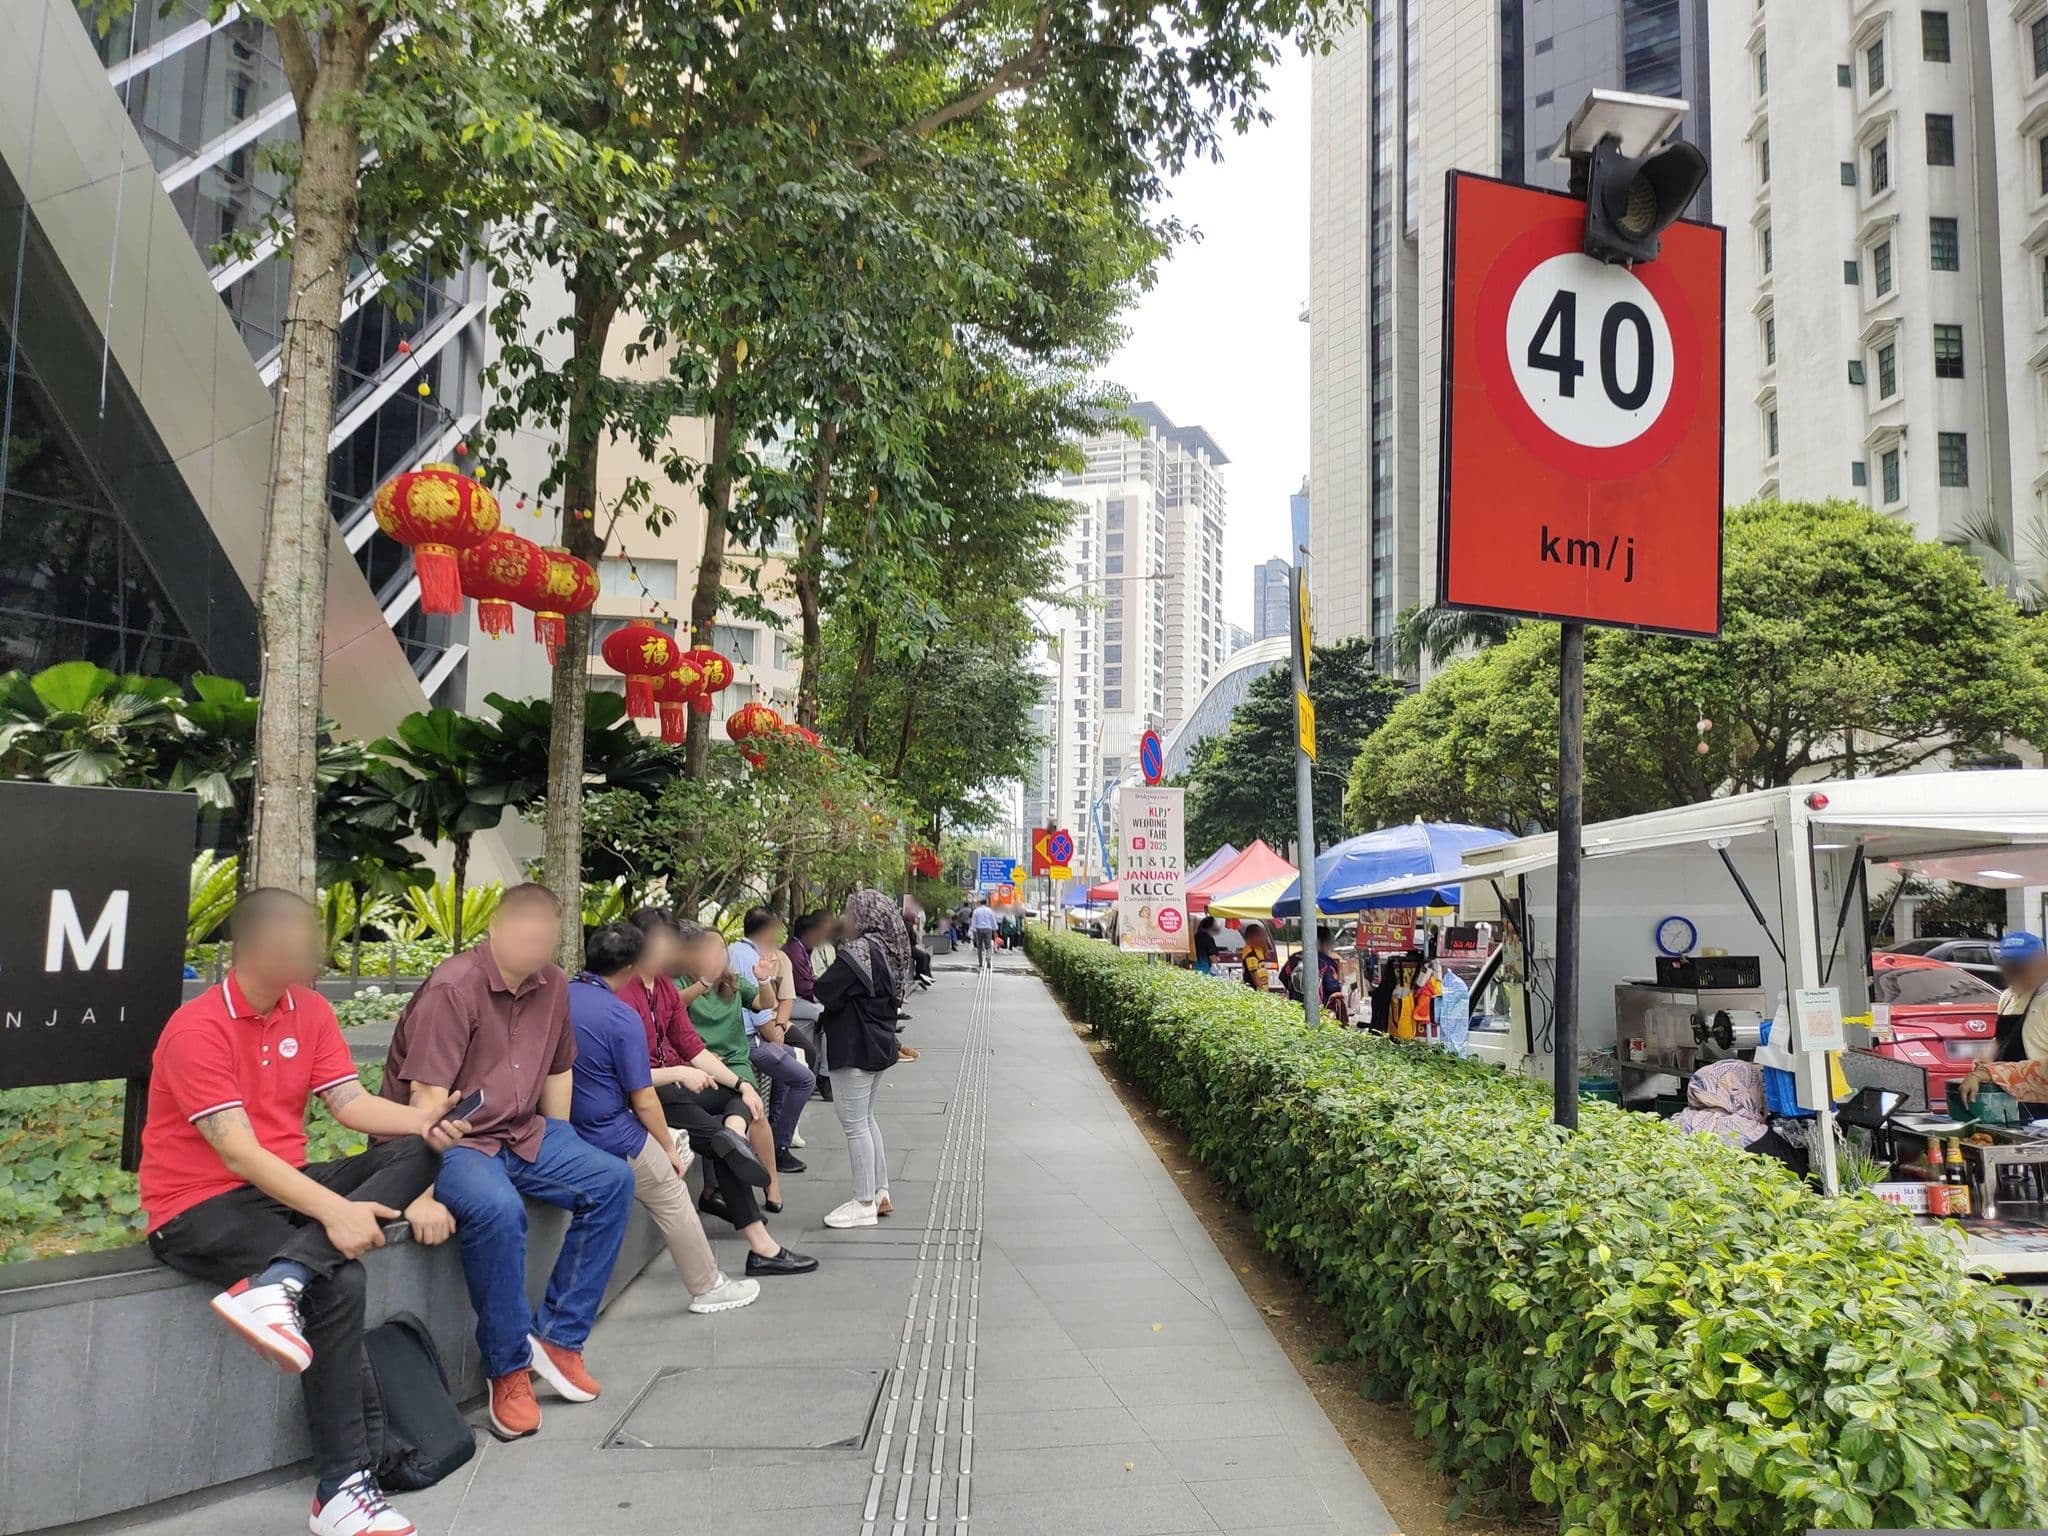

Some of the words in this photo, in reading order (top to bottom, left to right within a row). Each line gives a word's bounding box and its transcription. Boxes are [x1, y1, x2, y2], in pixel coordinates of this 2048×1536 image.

[1527, 289, 1655, 411] 40
[1540, 525, 1635, 583] km/j
[640, 635, 670, 666] 福
[1148, 806, 1167, 817] KLPJ
[1132, 818, 1168, 829] WEDDING
[1149, 829, 1167, 840] FAIR
[1150, 840, 1168, 851] 2025
[1128, 856, 1143, 868] 11
[1148, 856, 1157, 867] &
[1160, 856, 1177, 869] 12
[1123, 870, 1181, 881] JANUARY
[1131, 883, 1174, 896] KLCC
[1393, 928, 1402, 941] 6
